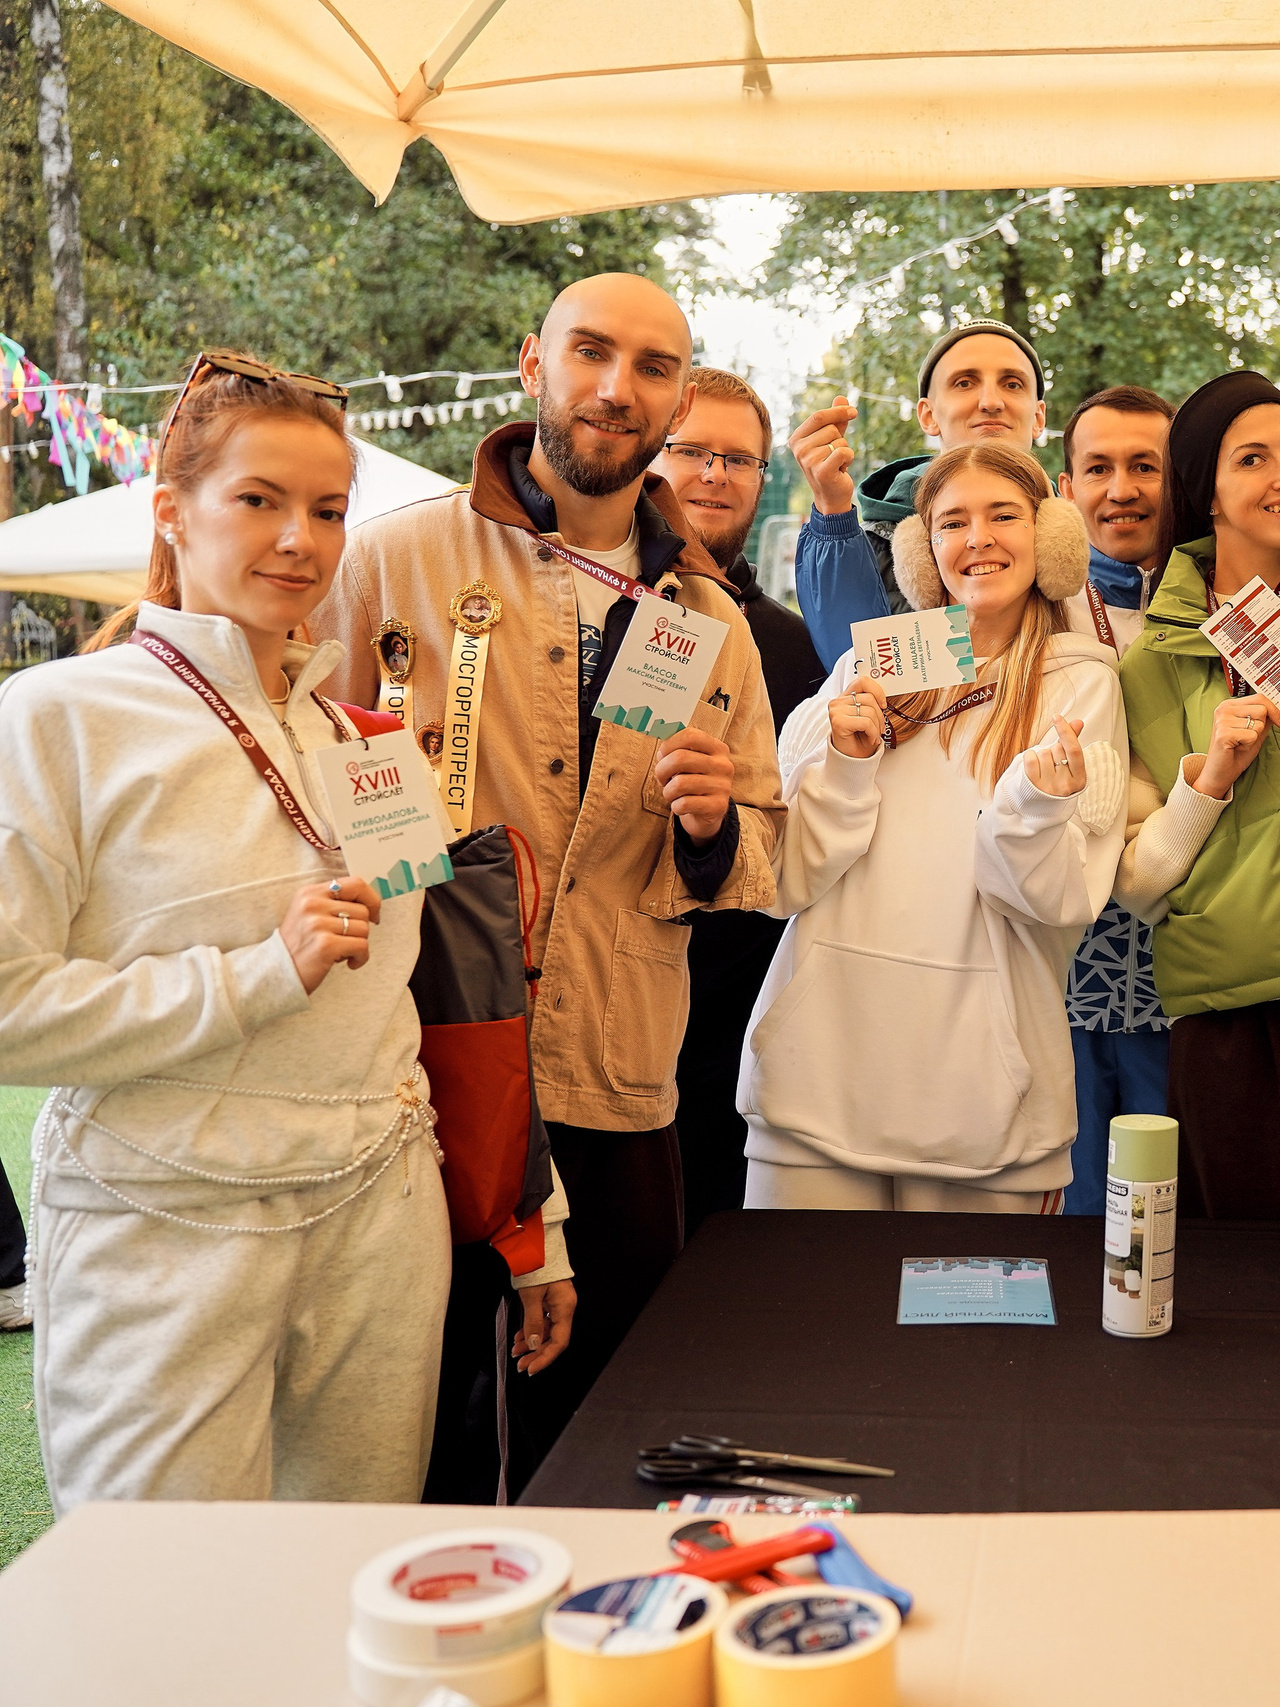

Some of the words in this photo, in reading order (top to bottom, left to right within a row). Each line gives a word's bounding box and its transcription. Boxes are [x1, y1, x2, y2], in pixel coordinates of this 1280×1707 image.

[571, 555, 621, 587] ФУНДАМЕНТ
[620, 581, 628, 591] Я
[1088, 580, 1101, 609] ДАМЕНТ
[1096, 610, 1110, 640] ГОРОДА
[141, 637, 180, 665] ГОРОДА
[644, 643, 690, 665] СТРОЙСЛЁТ
[648, 627, 697, 657] XVIII
[891, 635, 904, 676] СТРОЙСЛЁТ
[876, 637, 896, 677] XVIII
[626, 666, 655, 681] МАКСИМ
[655, 676, 688, 692] СЕРГЕЕВИЧ
[643, 663, 677, 681] ВЛАСОВ
[173, 664, 231, 719] ФУНДАМЕНТ
[958, 688, 993, 708] ГОРОДА
[447, 635, 480, 810] МОСГОРГЕОТРЕСТ
[264, 767, 299, 815] ГОРОДА
[350, 767, 401, 796] XVIII
[353, 787, 404, 806] СТРОЙСЛЁТ
[352, 806, 419, 830] КРИВОЛАПОВА
[903, 1311, 939, 1319] ЛИСТ
[944, 1311, 1049, 1319] МАРШРУТНЫЙ
